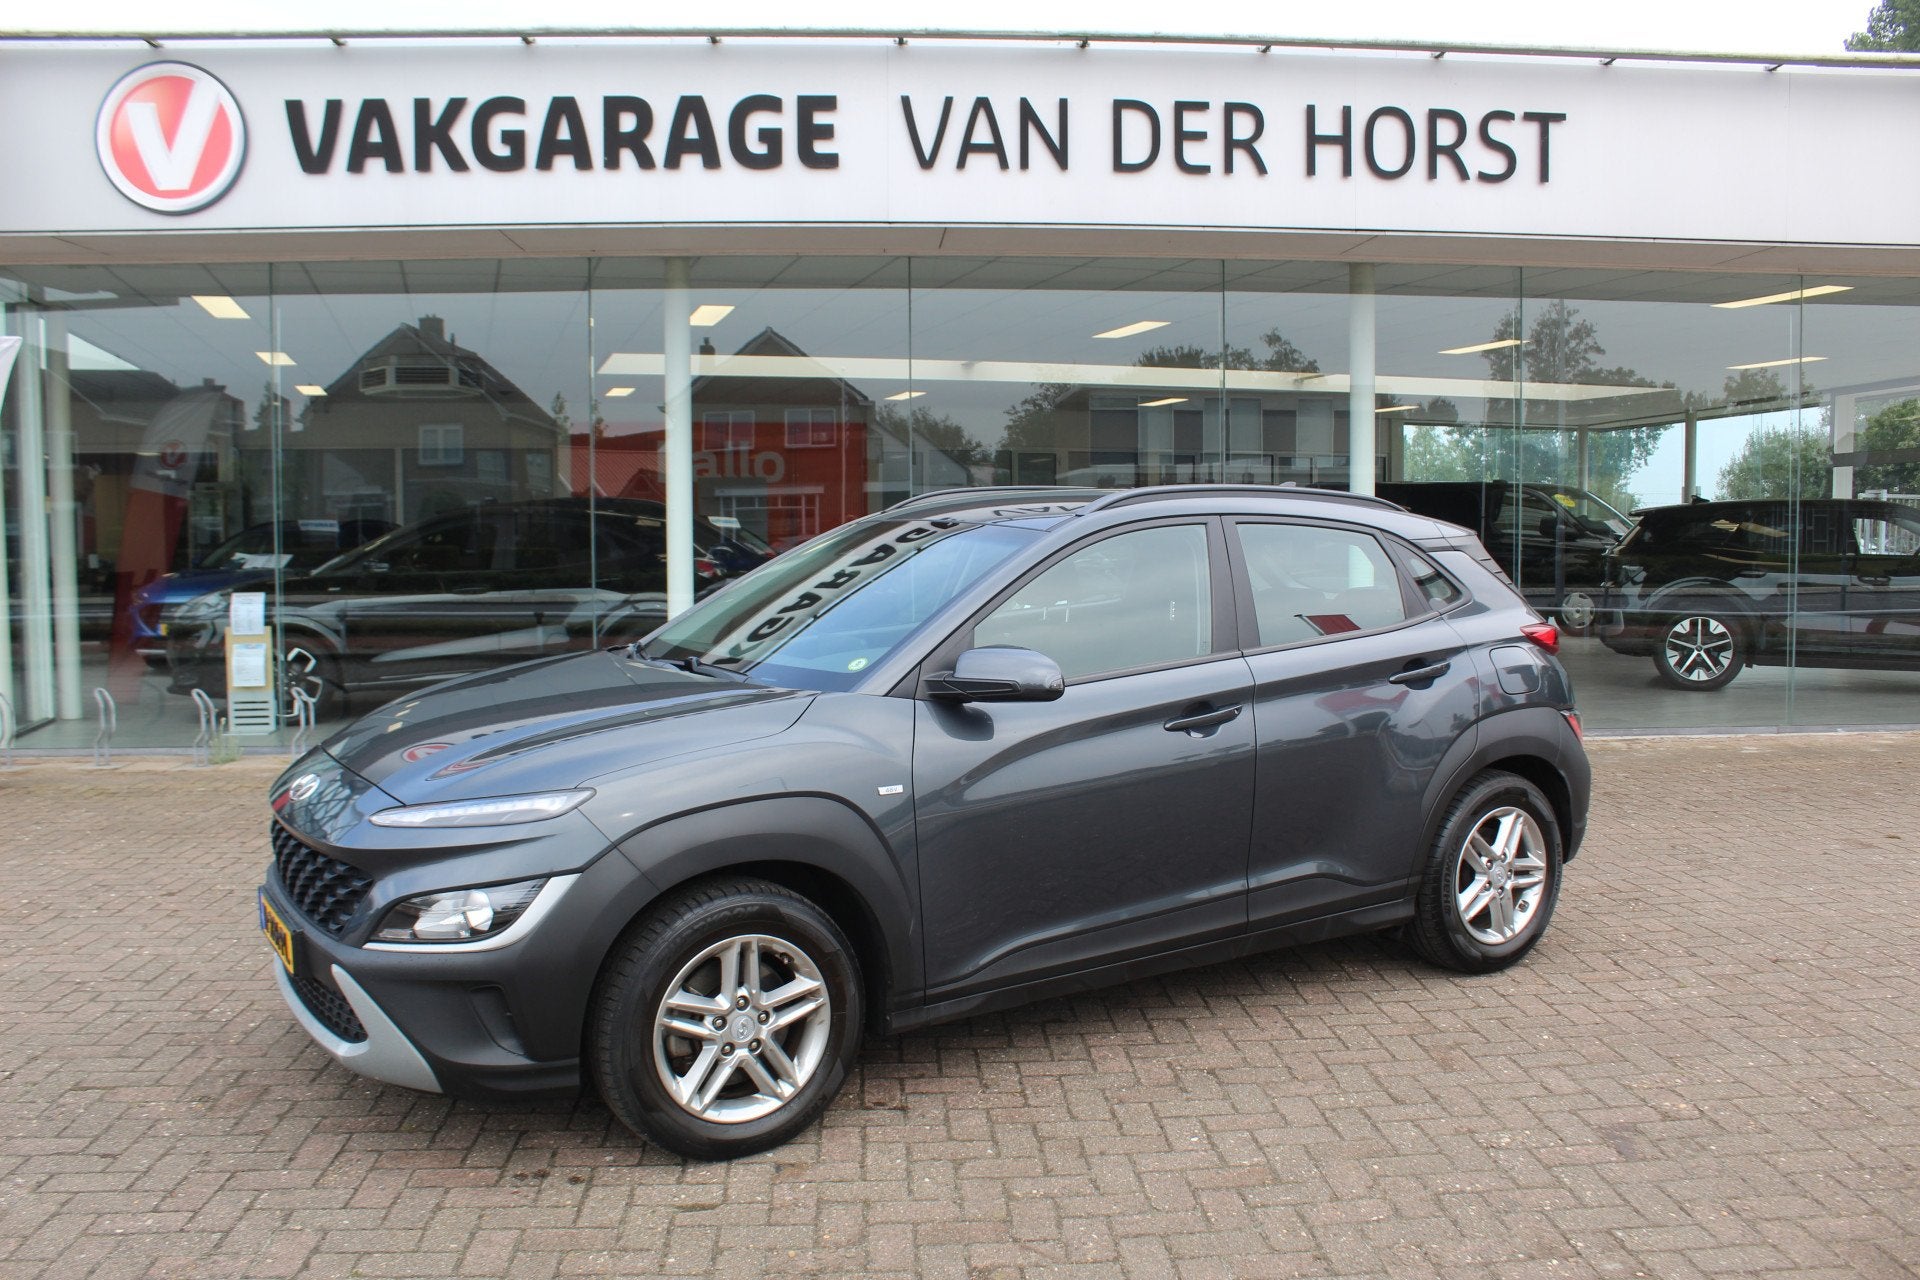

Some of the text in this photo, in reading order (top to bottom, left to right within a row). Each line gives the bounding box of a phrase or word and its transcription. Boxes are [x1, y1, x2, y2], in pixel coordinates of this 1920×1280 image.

[286, 95, 1566, 183] VAKGARAGE VAN DER HORST
[657, 440, 785, 483] allo
